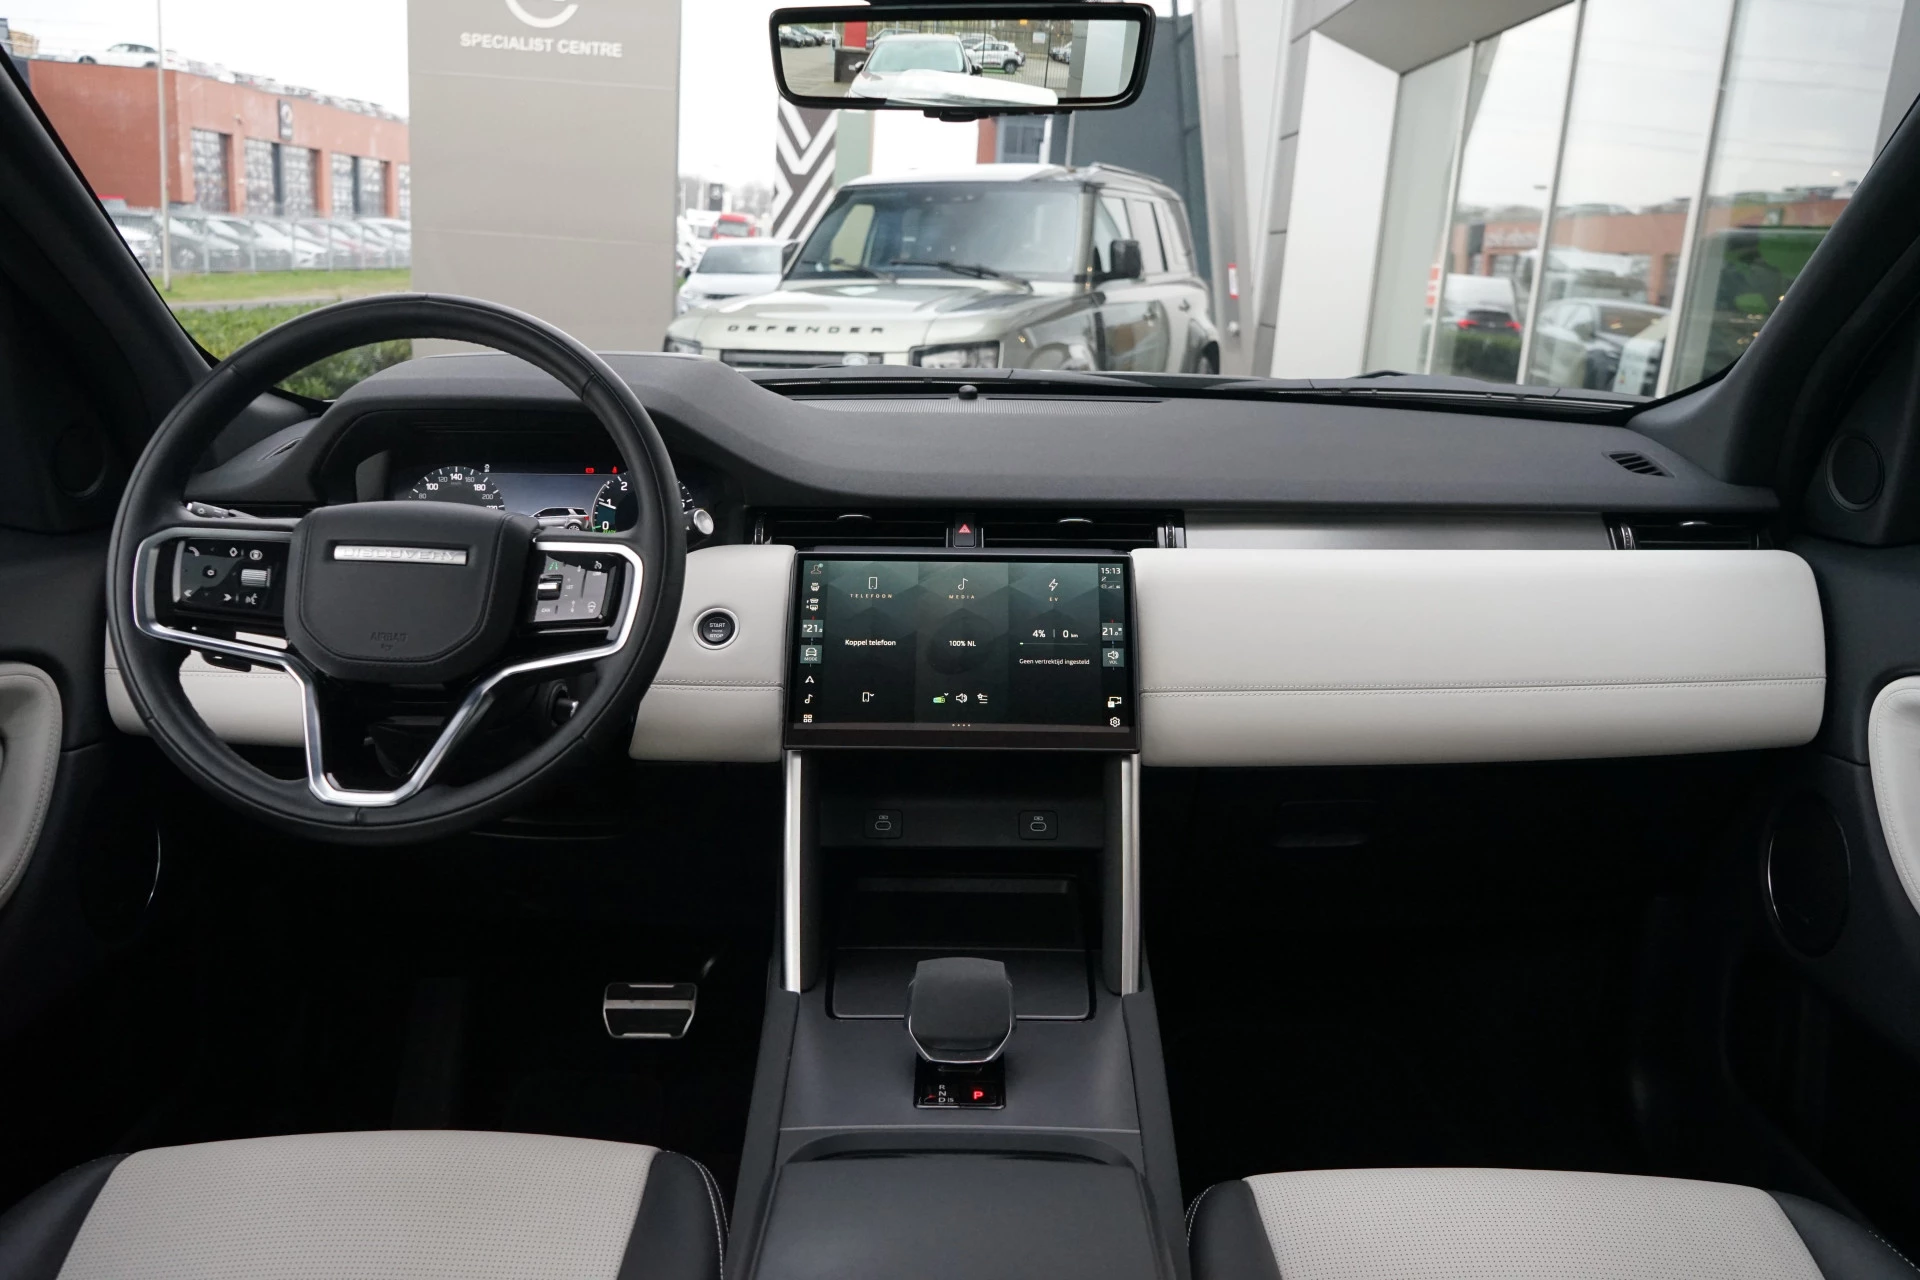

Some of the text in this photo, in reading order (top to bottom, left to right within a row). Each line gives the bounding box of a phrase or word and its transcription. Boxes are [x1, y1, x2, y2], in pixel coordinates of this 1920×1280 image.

[460, 32, 623, 58] SPECIALIST CENTRE
[727, 325, 884, 333] DEFENDER
[620, 482, 628, 490] 2
[602, 520, 609, 530] 0
[343, 548, 458, 561] DISCOVERY
[1032, 630, 1046, 638] 4%
[1062, 630, 1068, 638] 0
[974, 1090, 984, 1100] P
